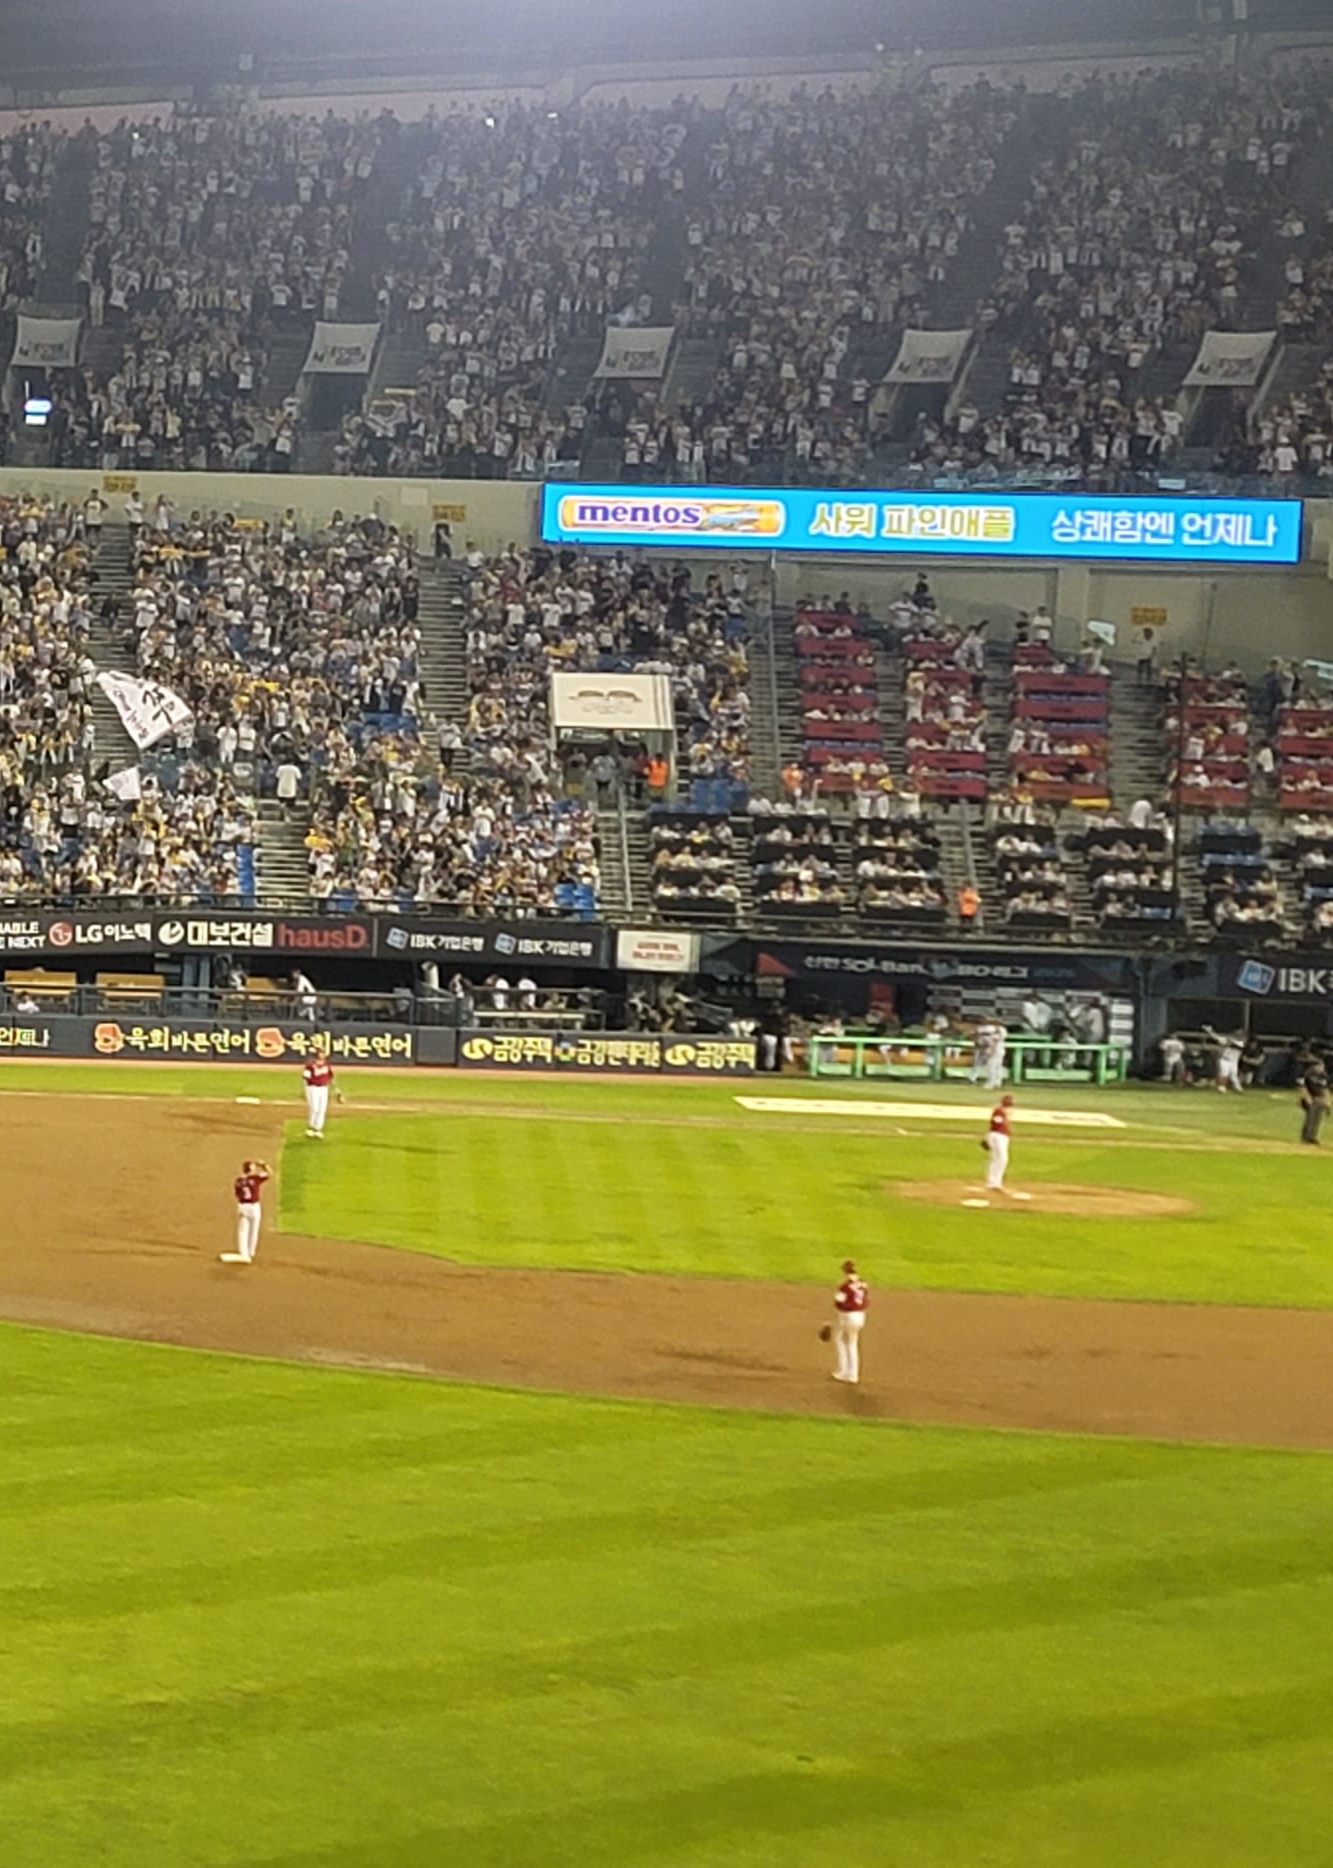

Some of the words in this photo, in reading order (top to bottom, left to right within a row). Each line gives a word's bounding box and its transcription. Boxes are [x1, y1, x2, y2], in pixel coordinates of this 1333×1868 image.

[577, 502, 701, 525] mentos
[811, 503, 874, 535] 사워
[884, 505, 1014, 541] 파인애플
[1051, 509, 1176, 544] 상쾌함엔
[1181, 513, 1277, 547] 언제나
[8, 935, 46, 949] NEXT
[187, 920, 274, 947] 대보건설
[277, 923, 367, 949] hausD
[1278, 967, 1333, 995] IBK
